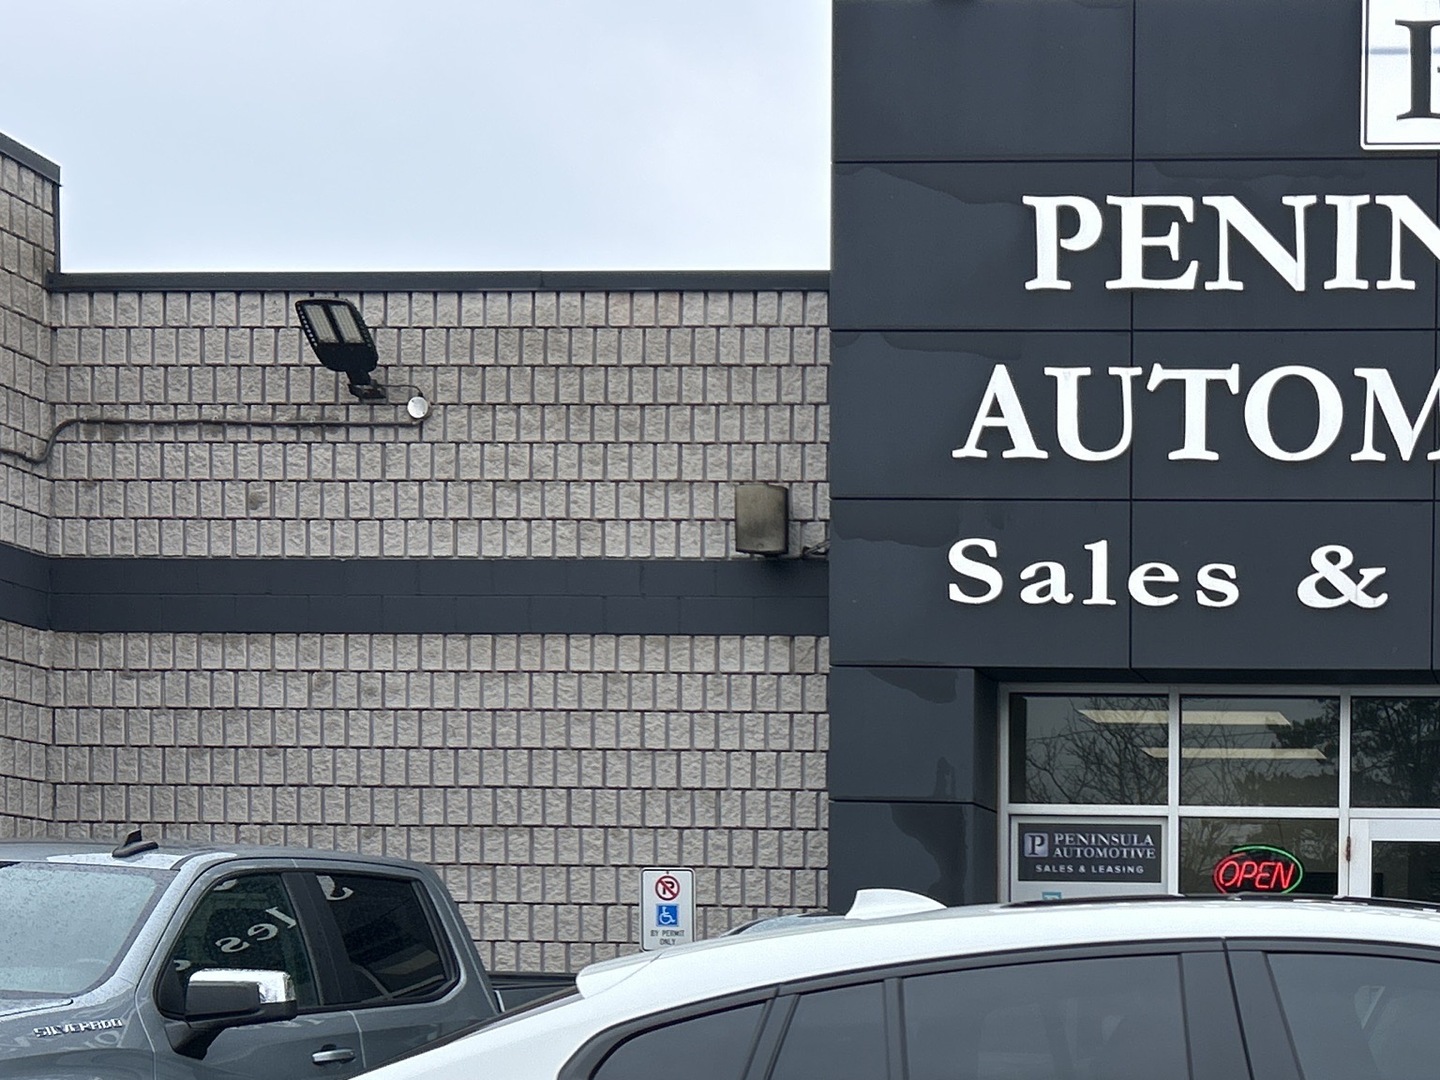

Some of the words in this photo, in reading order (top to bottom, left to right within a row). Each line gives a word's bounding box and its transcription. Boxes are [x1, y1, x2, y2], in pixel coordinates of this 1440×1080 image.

[948, 537, 1240, 608] Sales
[1297, 544, 1389, 609] &
[1029, 834, 1045, 856] P
[1054, 833, 1154, 847] PENINSULA
[1053, 847, 1156, 859] AUTOMOTIVE
[1035, 864, 1074, 873] SALES
[1079, 865, 1086, 873] &
[1091, 865, 1144, 874] LEASING
[1219, 860, 1295, 889] OPEN
[32, 1018, 123, 1038] SILVERADO
